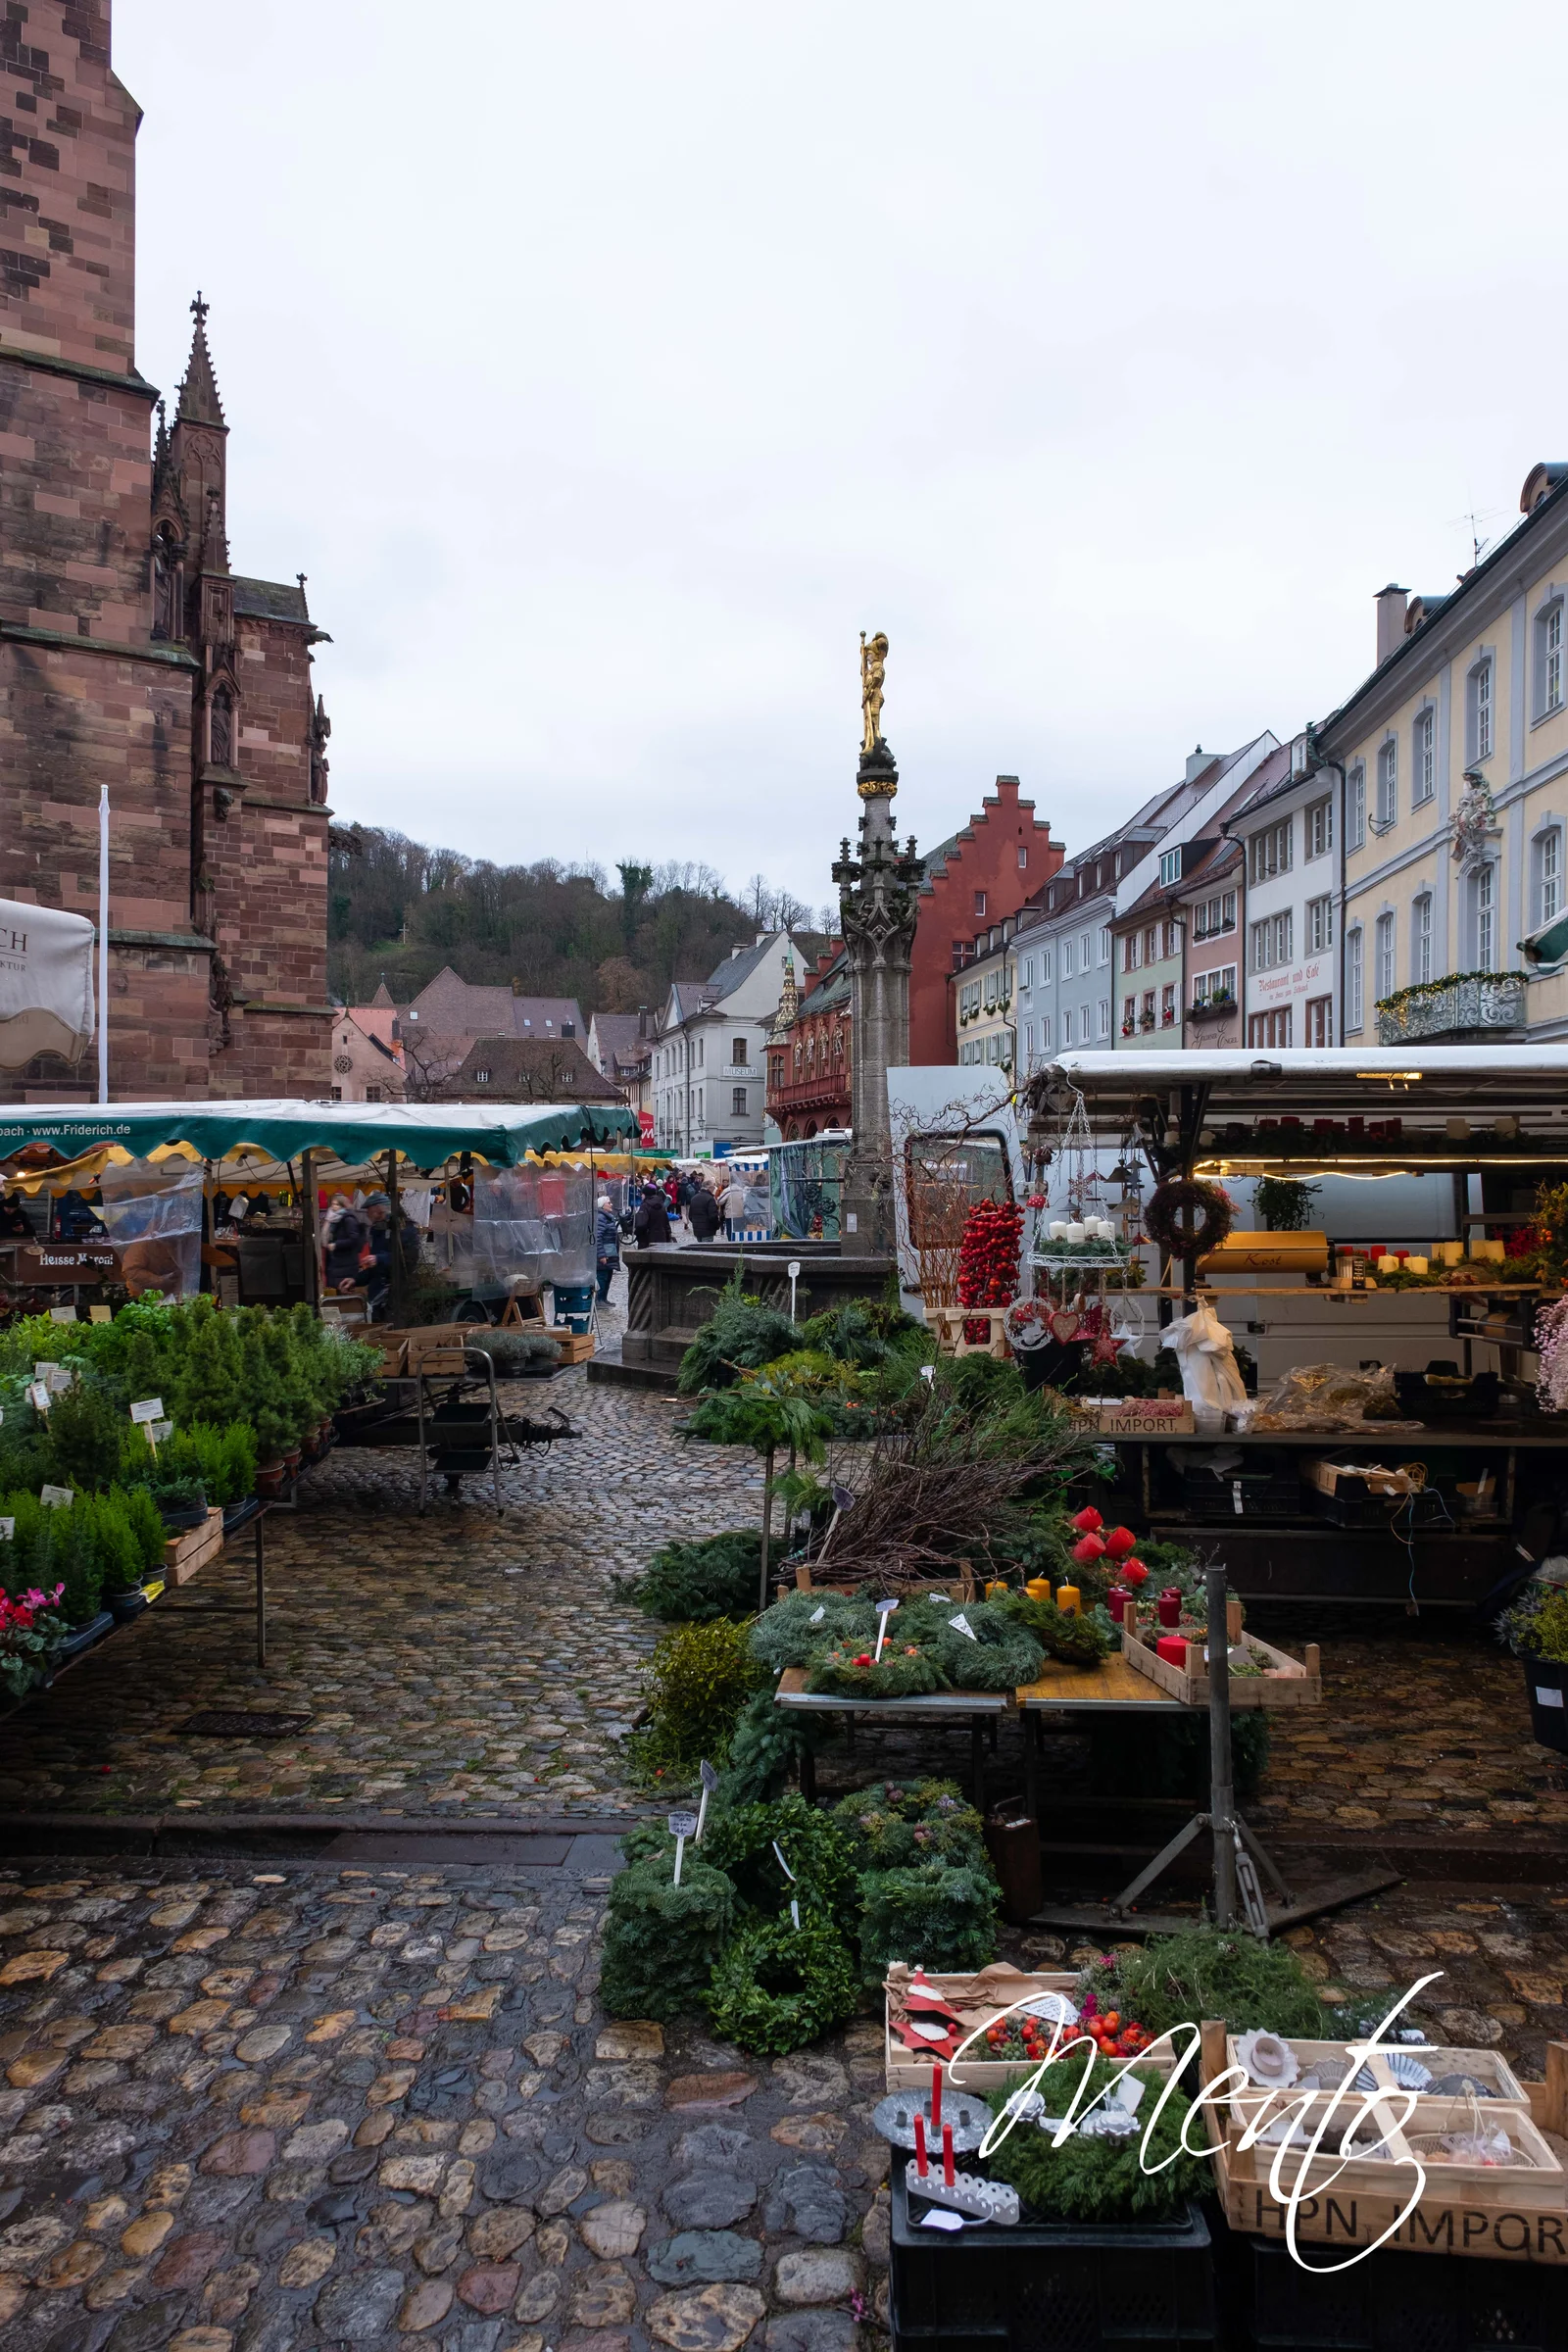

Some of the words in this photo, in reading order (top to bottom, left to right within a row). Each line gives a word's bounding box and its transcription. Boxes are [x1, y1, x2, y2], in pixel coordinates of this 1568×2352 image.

[1258, 972, 1290, 992] Restaurant
[1292, 968, 1303, 984] und
[725, 1067, 757, 1076] MUSEUM
[32, 1123, 131, 1136] www.Friderich.de
[39, 1253, 74, 1266] Heisse
[76, 1252, 114, 1266] Mroni
[1109, 1418, 1176, 1432] IMPORT
[1255, 2188, 1357, 2238] HPN
[1393, 2203, 1568, 2255] IMPOR
